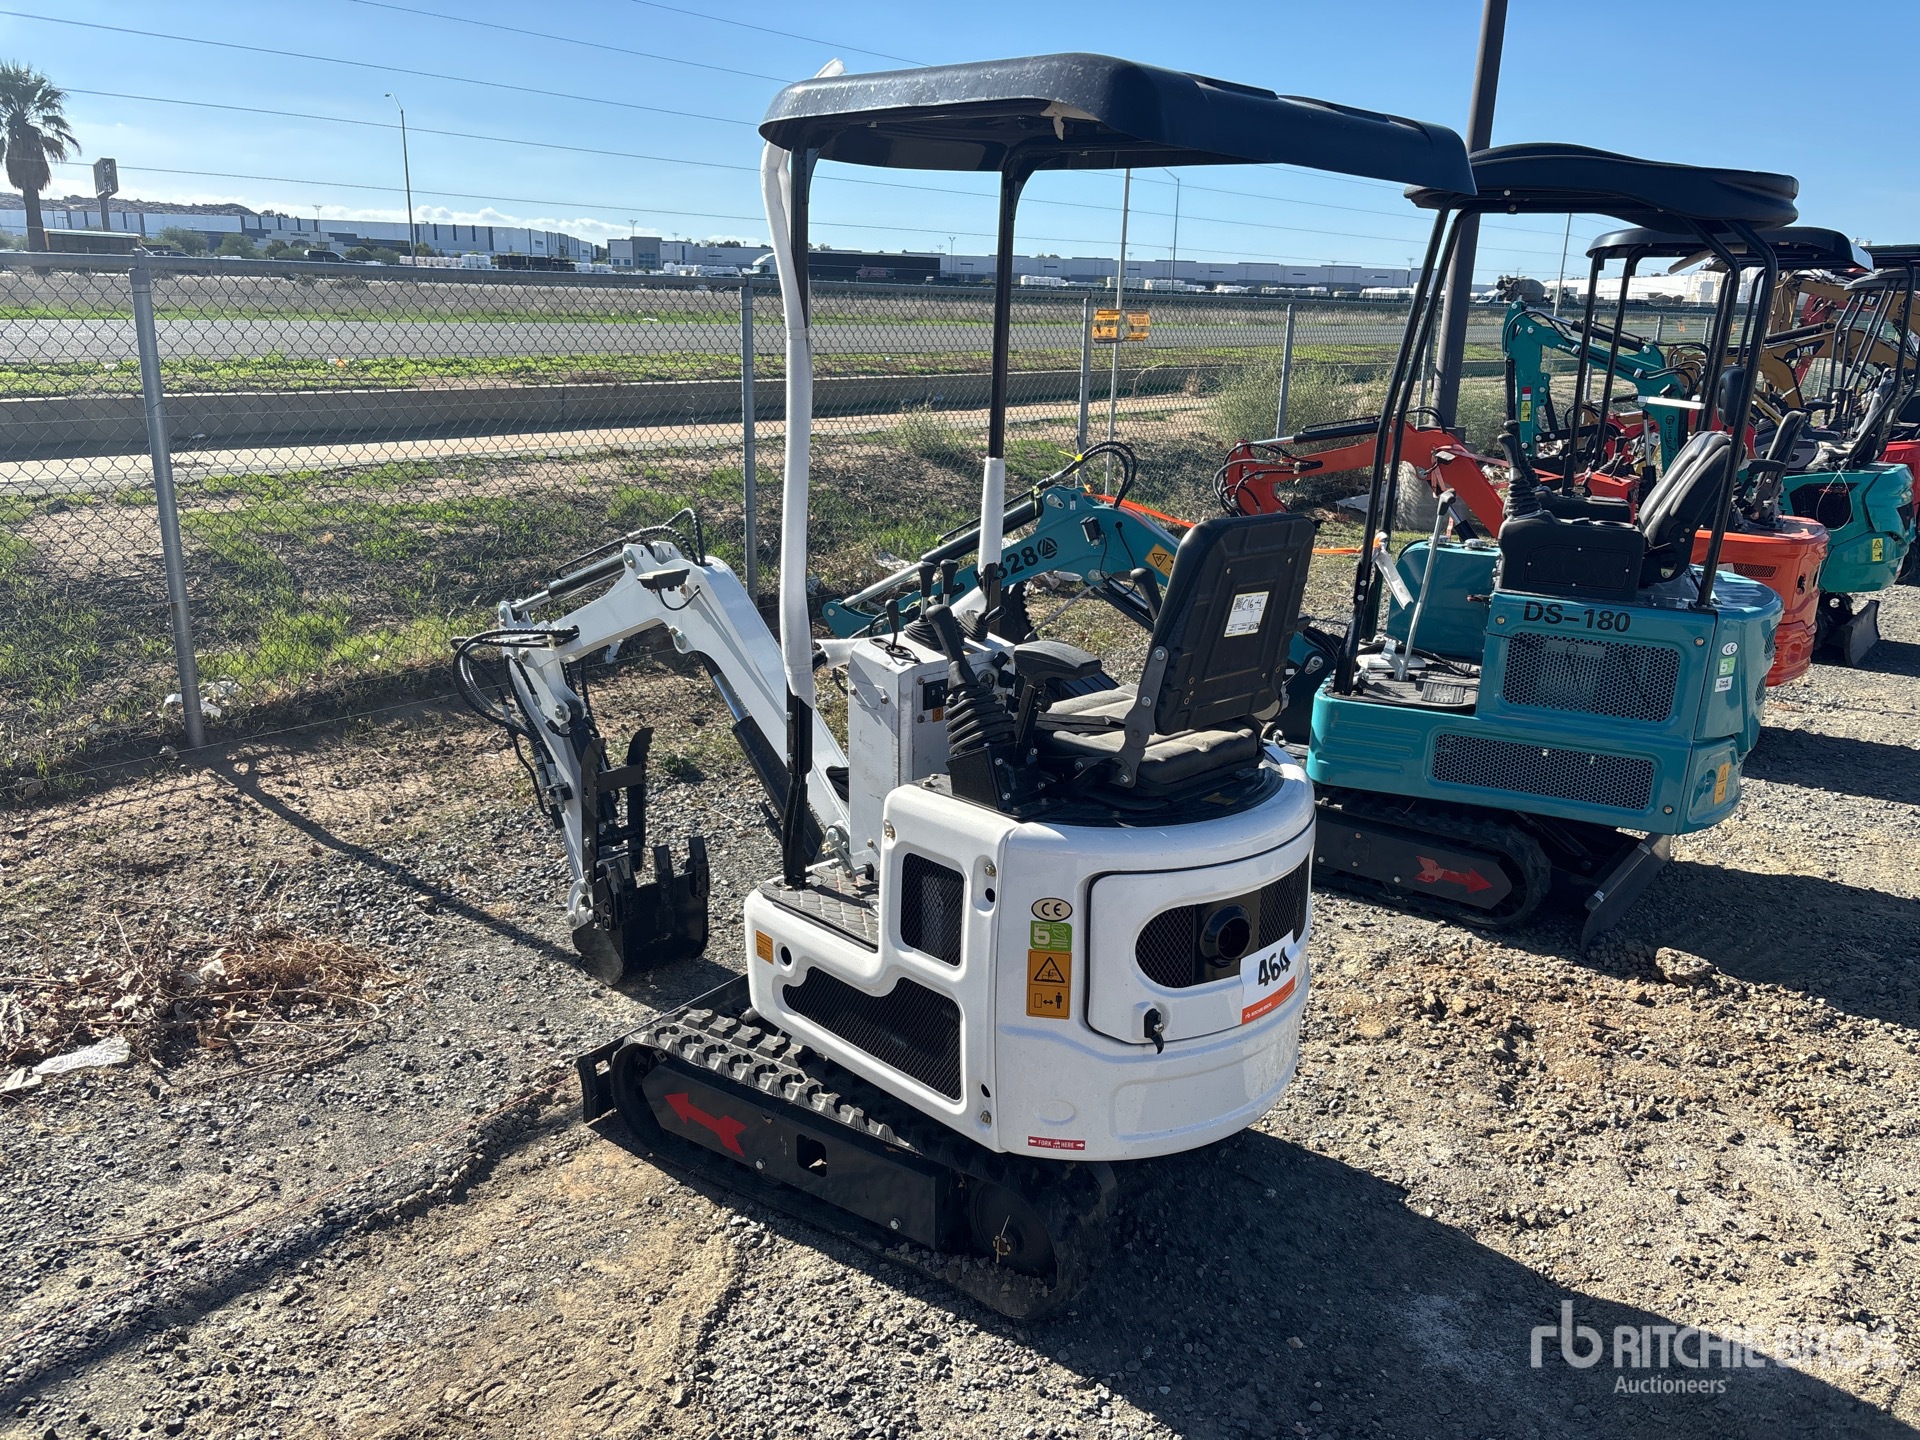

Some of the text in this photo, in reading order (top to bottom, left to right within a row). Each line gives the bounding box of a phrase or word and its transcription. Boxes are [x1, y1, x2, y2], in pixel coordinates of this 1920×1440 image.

[1523, 600, 1631, 633] DS-180
[1041, 902, 1062, 917] CE
[1258, 946, 1291, 987] 464
[1038, 1139, 1052, 1147] FORK
[1061, 1141, 1075, 1149] HERE
